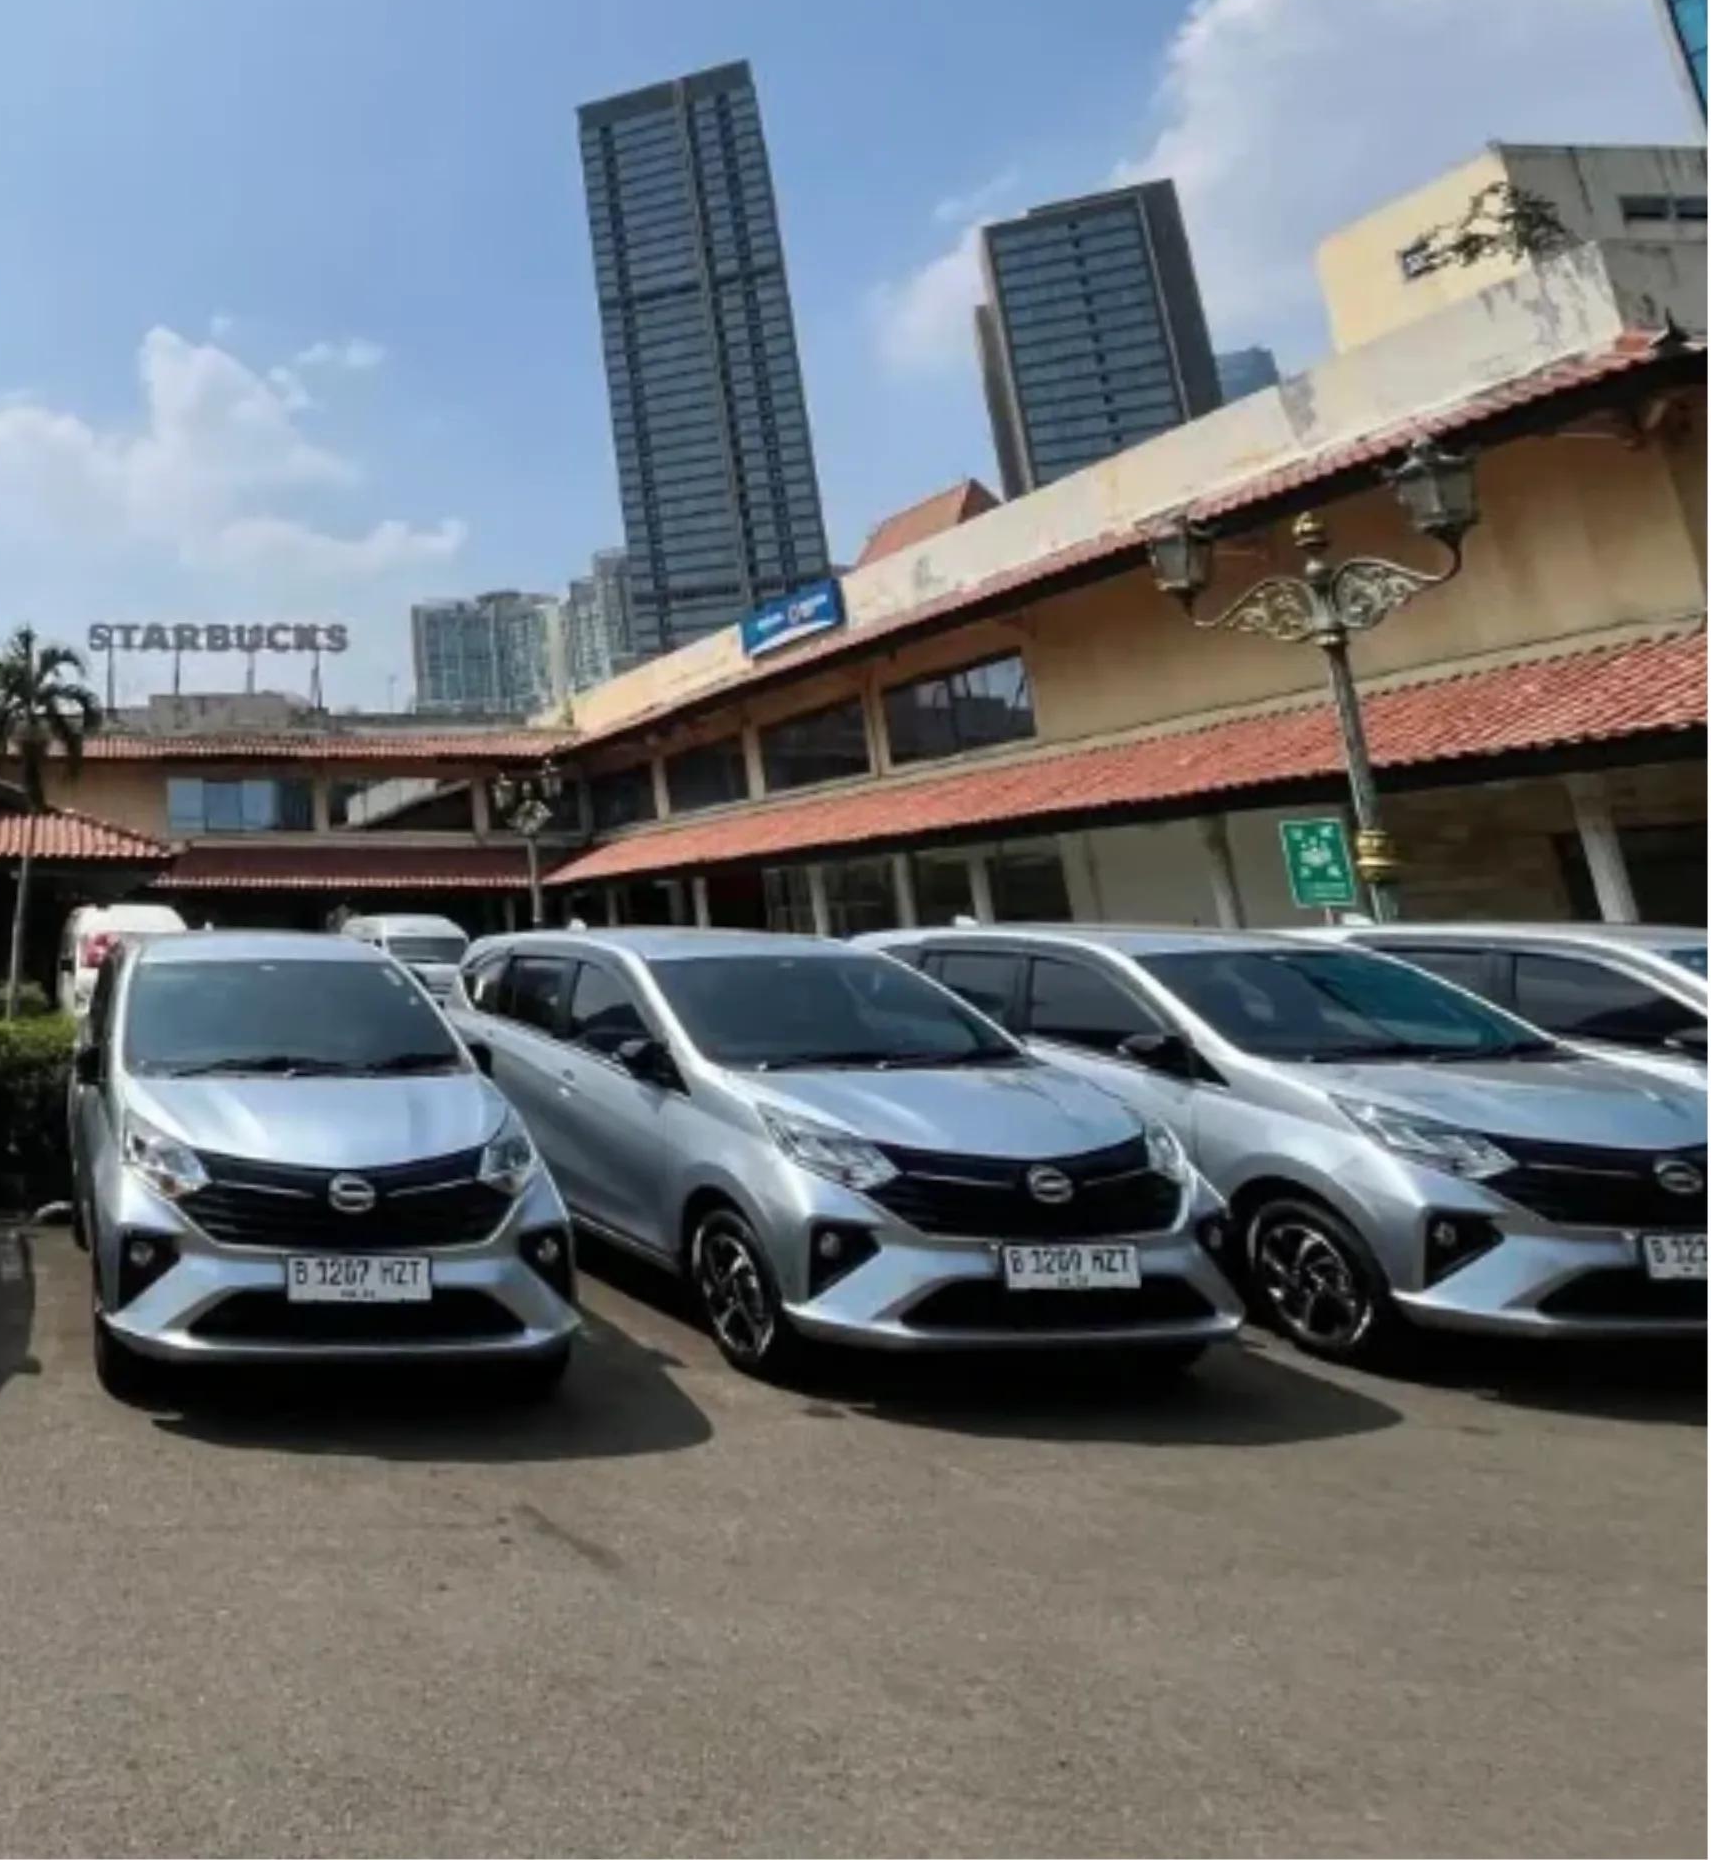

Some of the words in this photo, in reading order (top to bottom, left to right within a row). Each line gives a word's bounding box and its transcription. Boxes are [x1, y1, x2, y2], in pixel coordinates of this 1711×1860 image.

[89, 623, 348, 653] STARBUCKS
[1010, 1249, 1024, 1274] B
[1651, 1238, 1667, 1264] B
[294, 1260, 308, 1285] B
